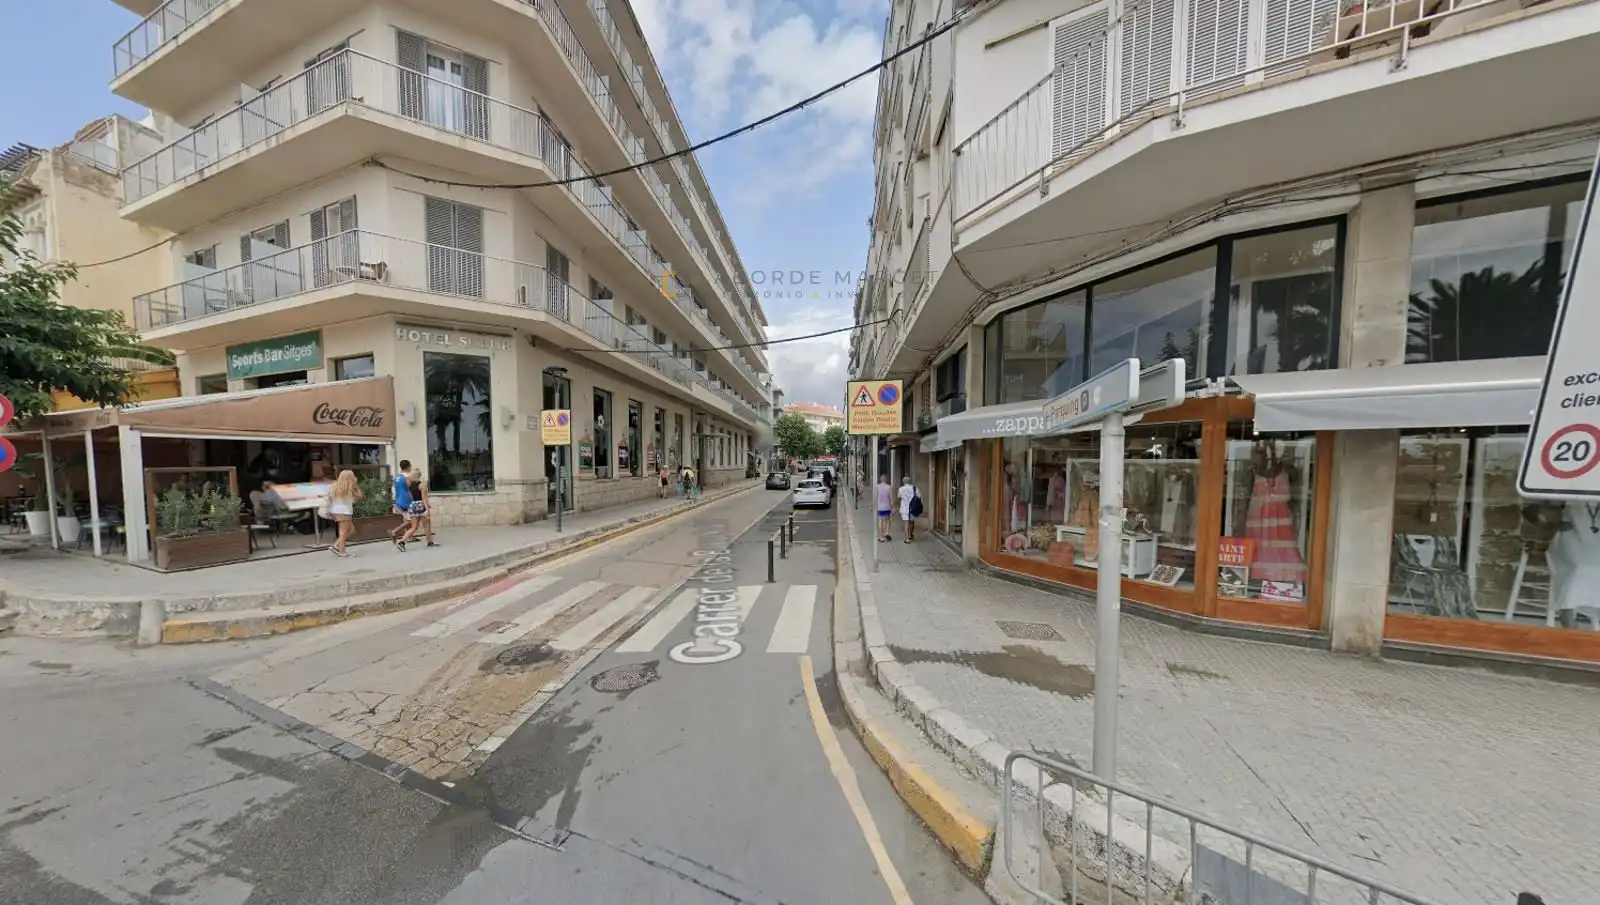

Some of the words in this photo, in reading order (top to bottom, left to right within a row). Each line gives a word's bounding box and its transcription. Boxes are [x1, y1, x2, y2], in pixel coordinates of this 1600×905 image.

[396, 328, 453, 346] HOTEL
[232, 351, 263, 370] Sports
[1553, 440, 1590, 462] 20
